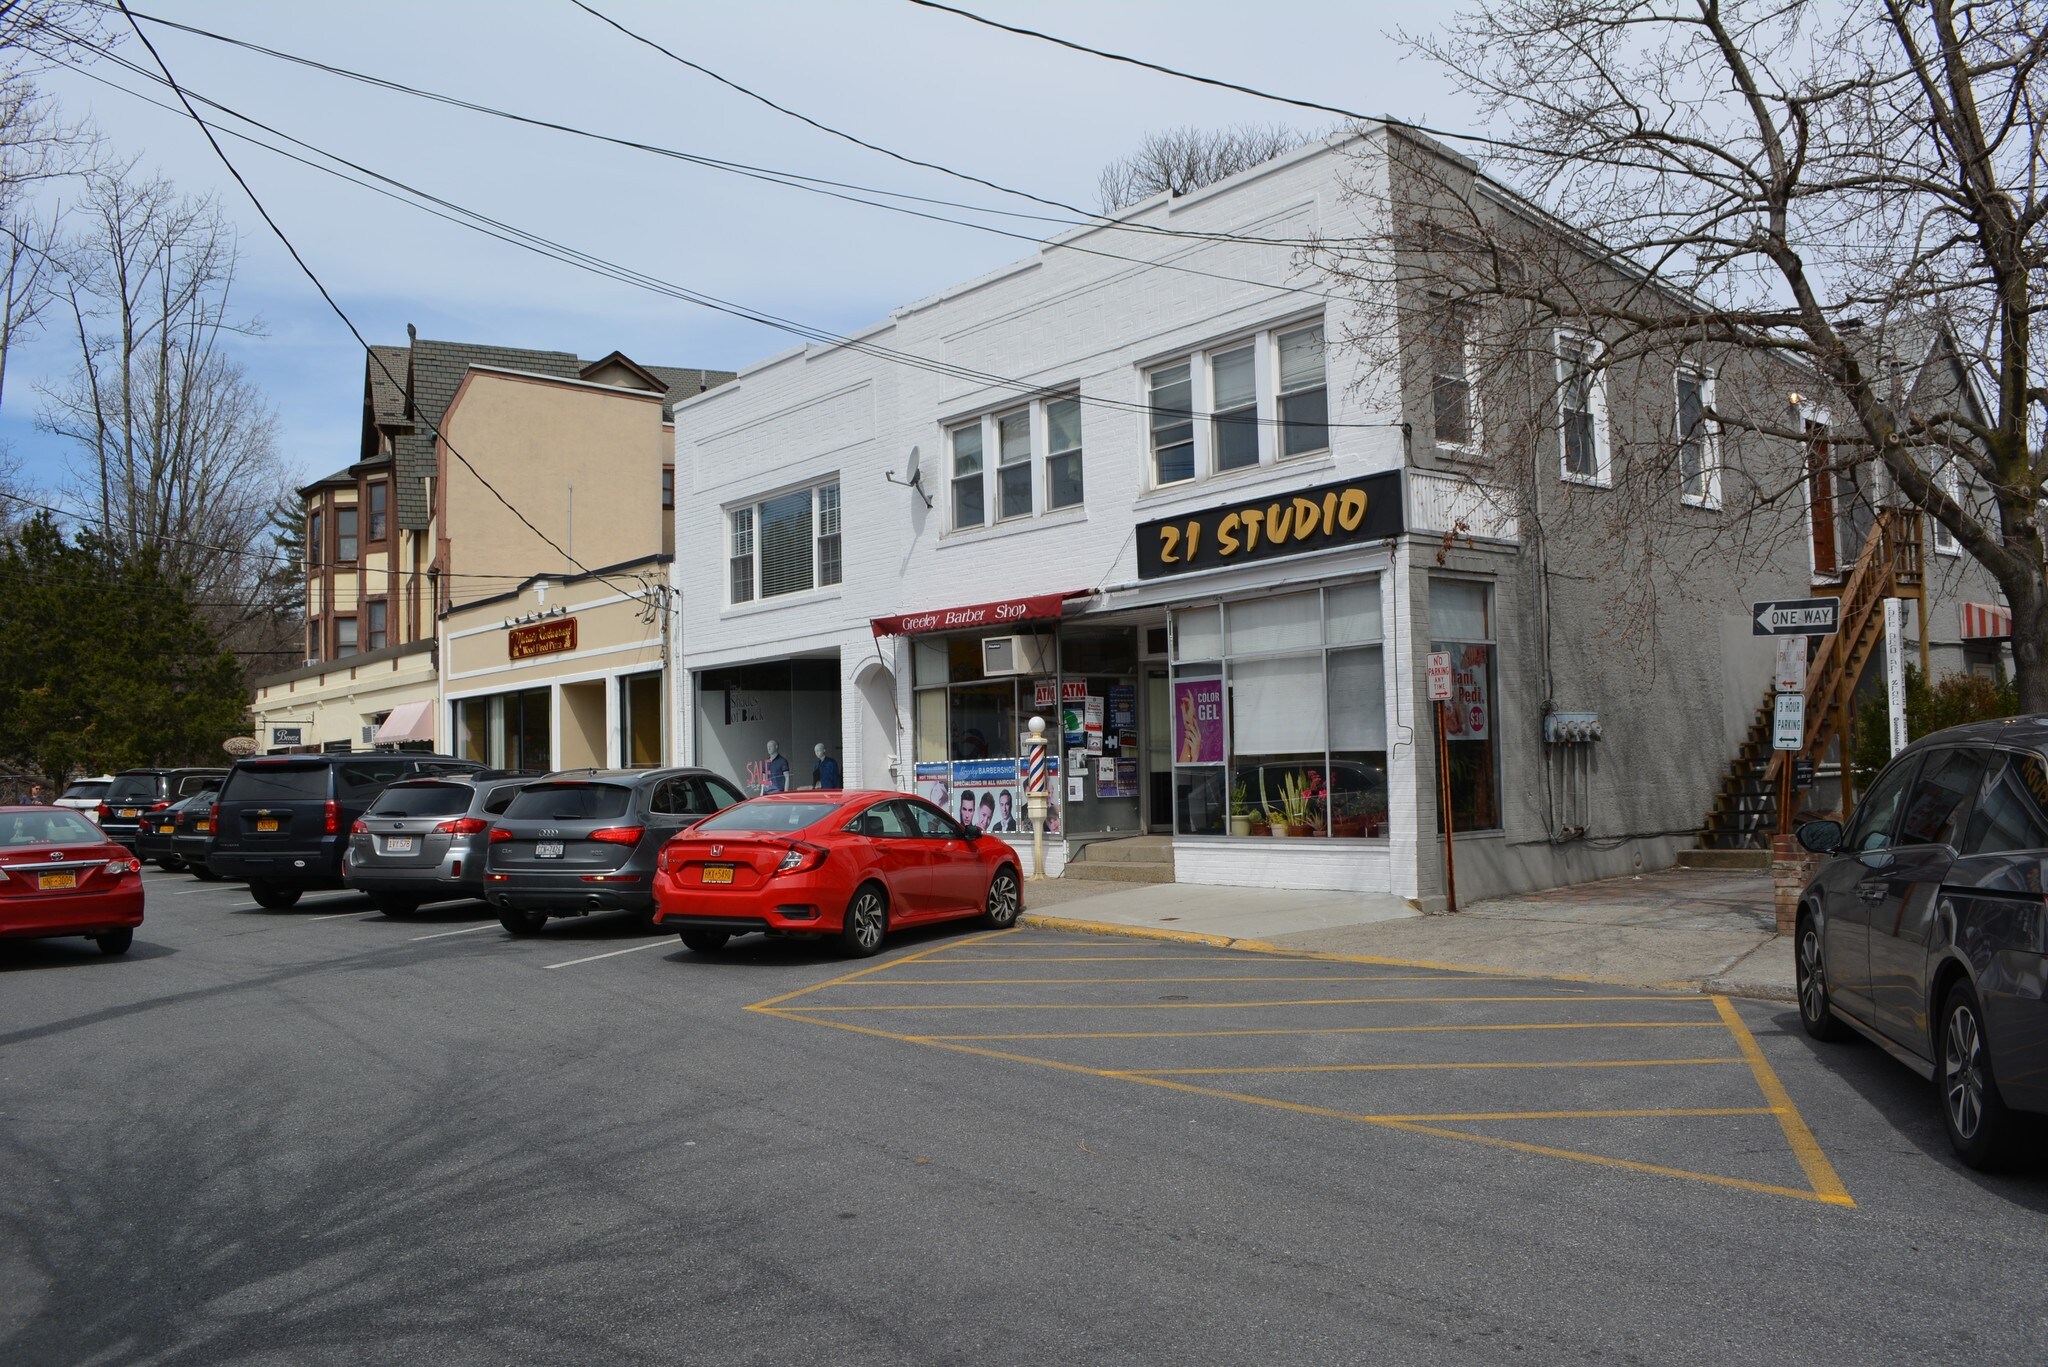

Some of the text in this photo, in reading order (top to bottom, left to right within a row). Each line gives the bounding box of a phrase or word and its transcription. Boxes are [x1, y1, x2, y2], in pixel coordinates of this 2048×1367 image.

[1159, 488, 1368, 563] 21 STUDIO
[902, 603, 1026, 631] Greeley Barber Shop
[1771, 609, 1830, 625] ONE WAY
[1433, 655, 1443, 666] NO
[1428, 667, 1449, 676] PARKING
[1062, 683, 1087, 697] ATM
[1197, 692, 1220, 703] COLOR
[1198, 704, 1220, 721] GEL
[1779, 701, 1800, 712] 3 HOUR
[742, 708, 764, 722] Black
[1470, 712, 1484, 726] $30
[1777, 720, 1801, 731] PARKING
[745, 759, 772, 786] SALE
[978, 766, 1016, 775] BARBERSHOP
